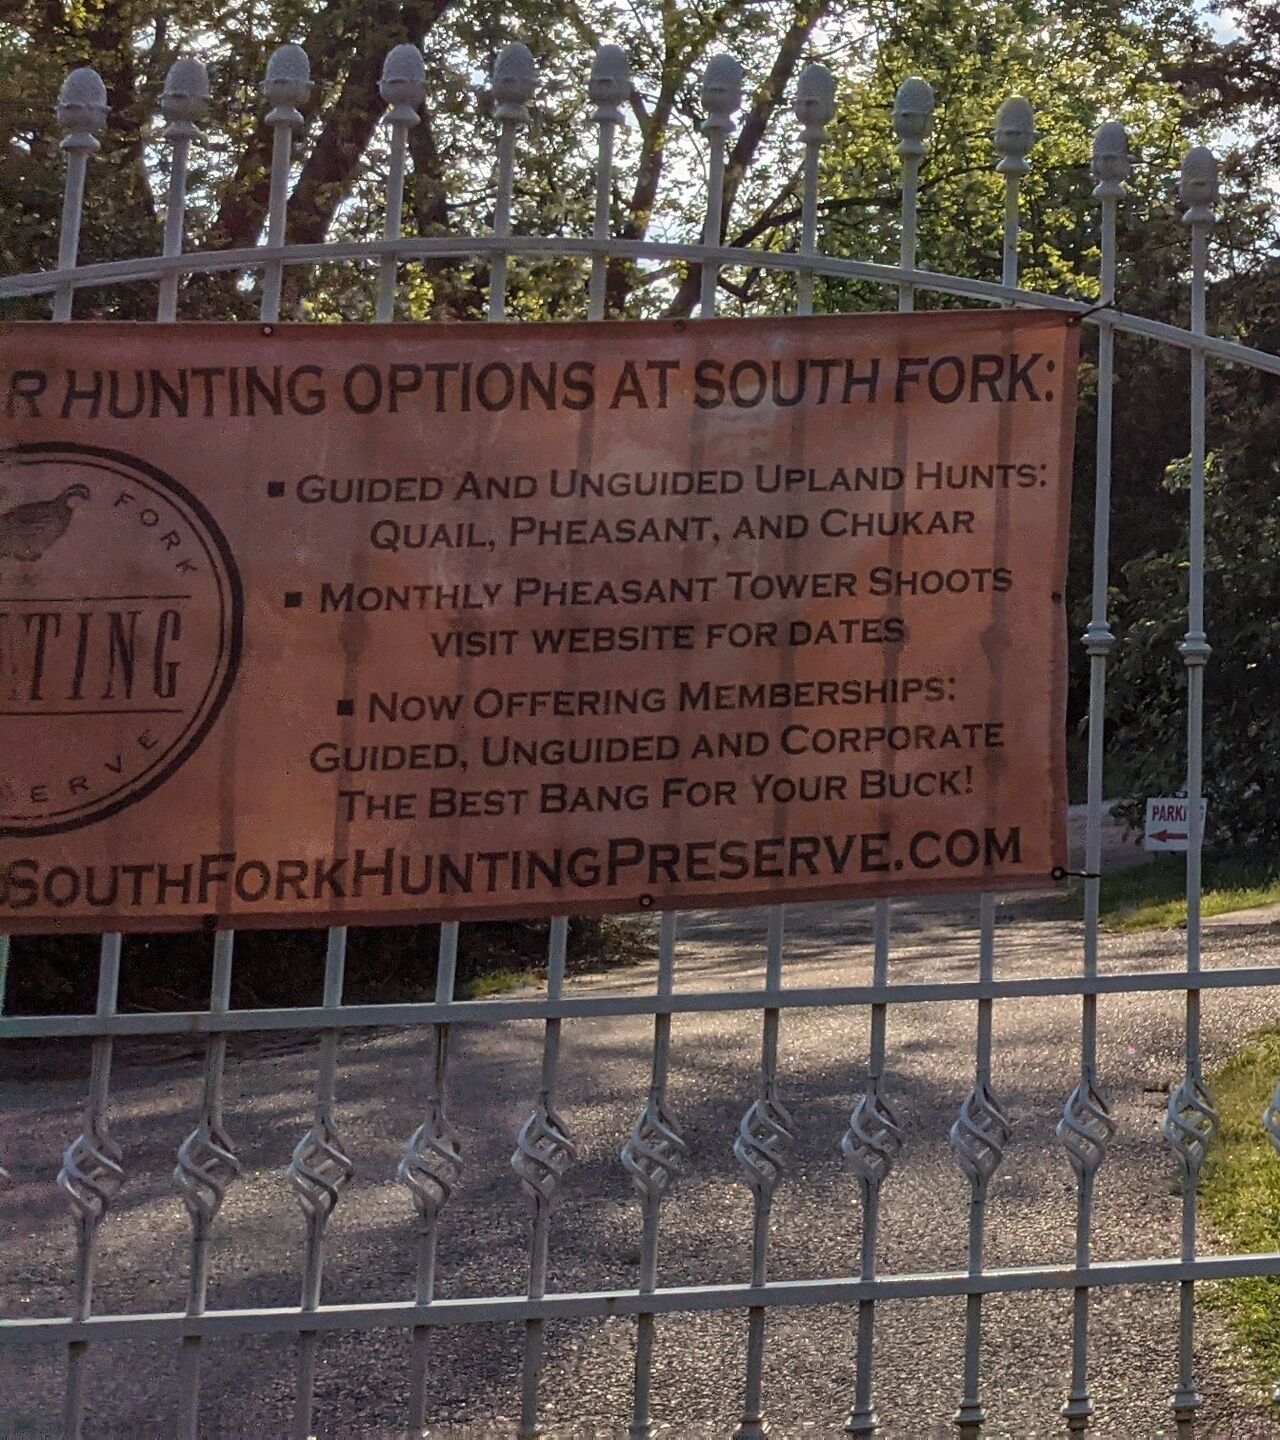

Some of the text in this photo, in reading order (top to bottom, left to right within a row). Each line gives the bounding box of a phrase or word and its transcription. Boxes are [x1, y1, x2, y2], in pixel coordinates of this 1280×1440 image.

[60, 365, 328, 420] HUNTING
[342, 359, 596, 414] OPTIONS
[608, 359, 681, 410] AT
[692, 357, 881, 410] SOUTH
[893, 352, 1056, 405] FORK:
[296, 461, 1048, 504] GUIDED AND UNGUIDED UPLAND HUNTS:
[113, 488, 198, 576] FORK
[370, 507, 976, 554] QUAIL, PHEASANT, AND CHUKAR
[320, 565, 1014, 614] MONTHLY PHEASANT TOWER SHOOTS
[431, 616, 906, 658] VISIT WEBSITE FOR DATES
[368, 675, 957, 724] NOW OFFERING MEMBERSHIPS:
[309, 721, 1006, 775] GUIDED, UNGUIDED AND CORPORATE
[338, 765, 976, 822] THE BEST BANG FOR YOUR BUCK!
